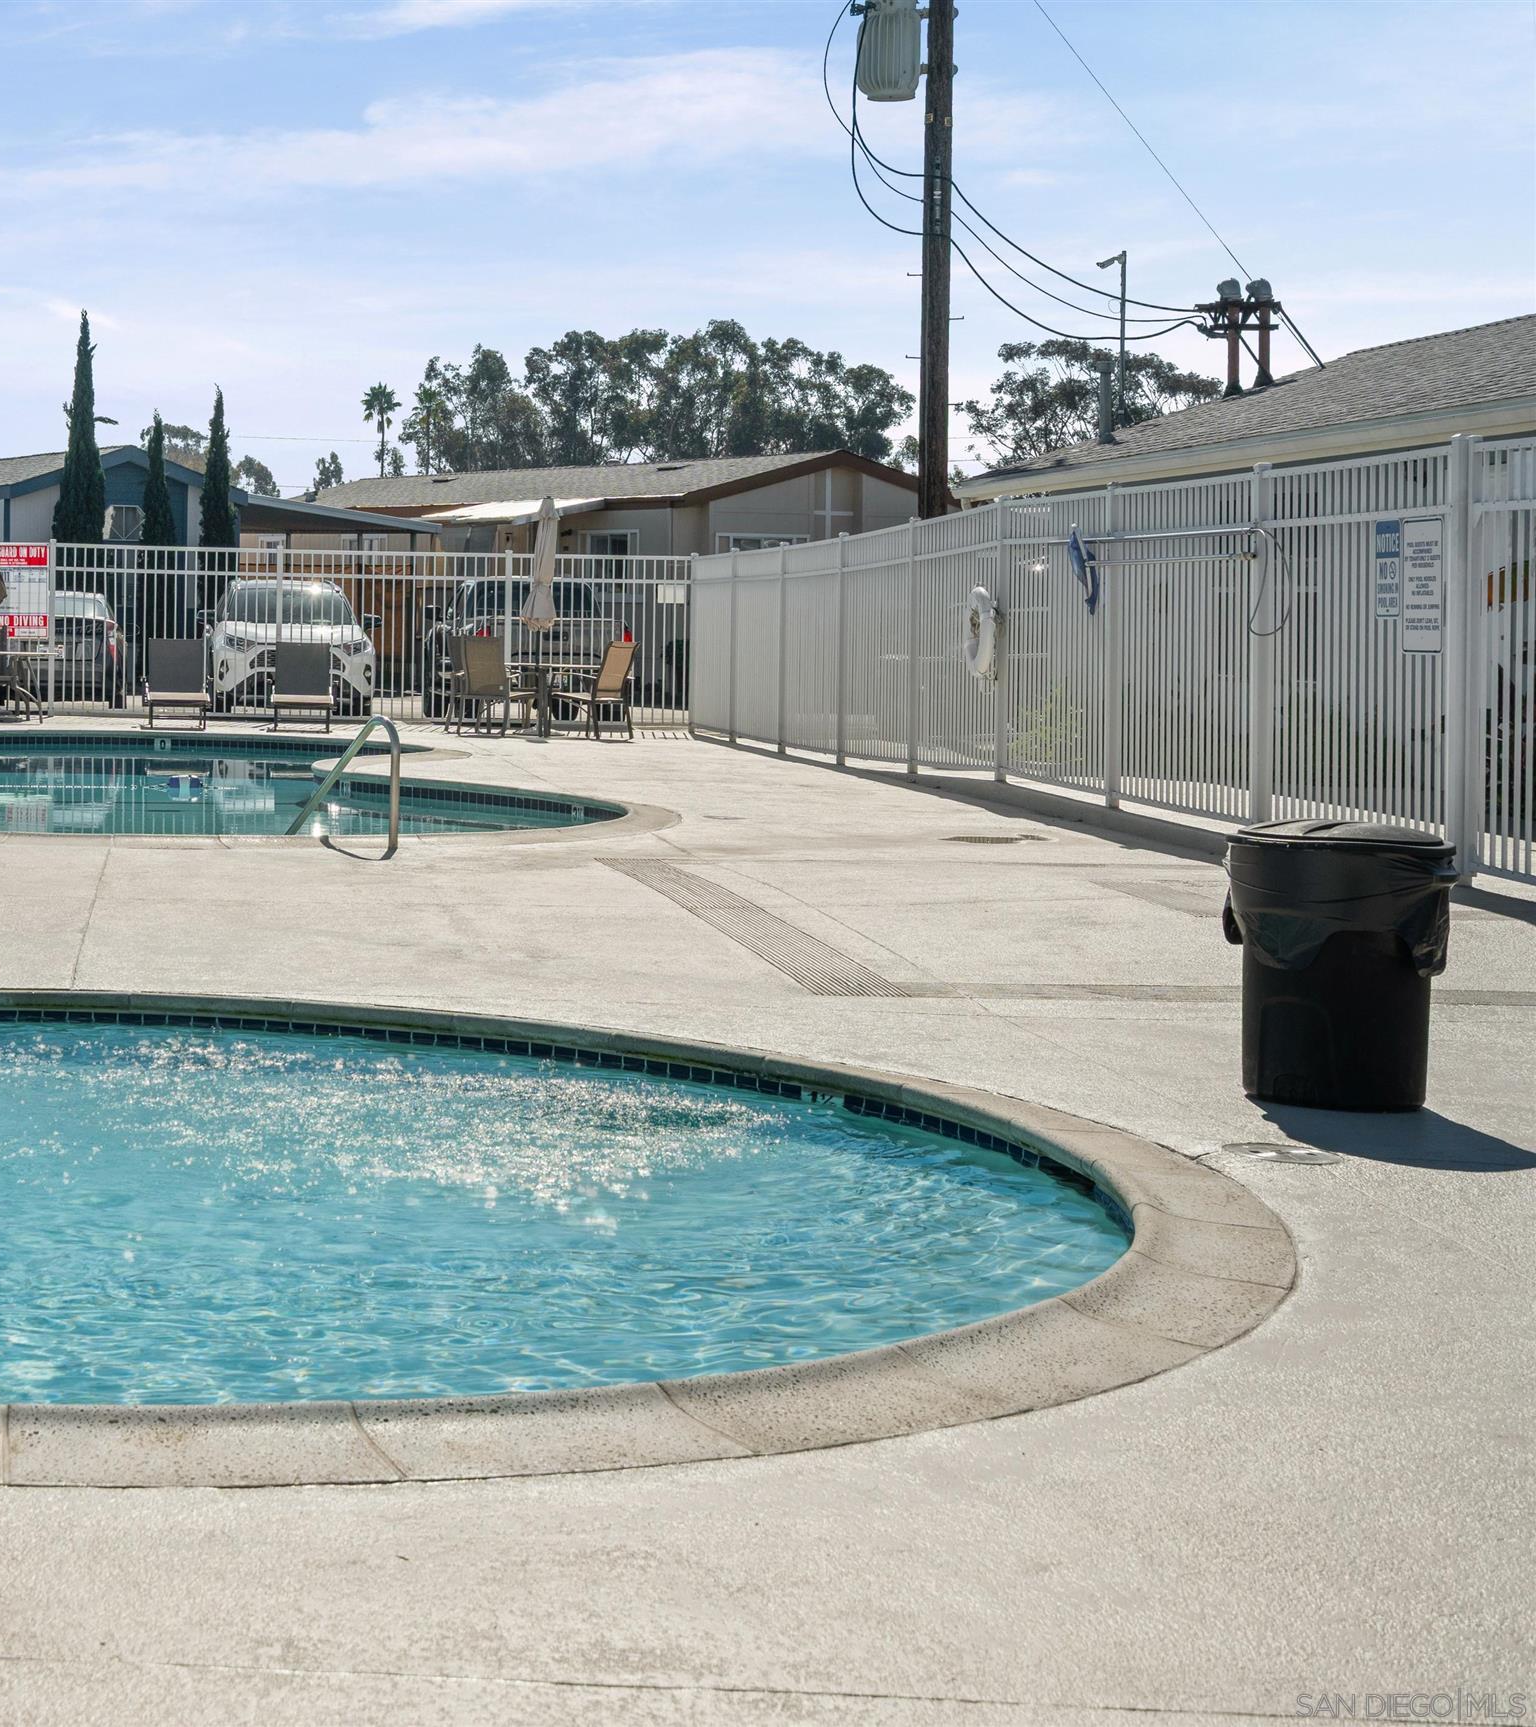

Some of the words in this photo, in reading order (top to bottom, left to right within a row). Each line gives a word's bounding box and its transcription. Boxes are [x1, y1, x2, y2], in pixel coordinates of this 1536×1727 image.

[1376, 533, 1399, 553] NOTICE
[19, 547, 28, 557] ON
[29, 547, 45, 558] DUTY
[1379, 561, 1388, 579] NO
[1377, 583, 1394, 594] SMOKING
[1378, 597, 1388, 608] POOL
[1388, 597, 1398, 608] AREA
[13, 616, 44, 627] DIVING
